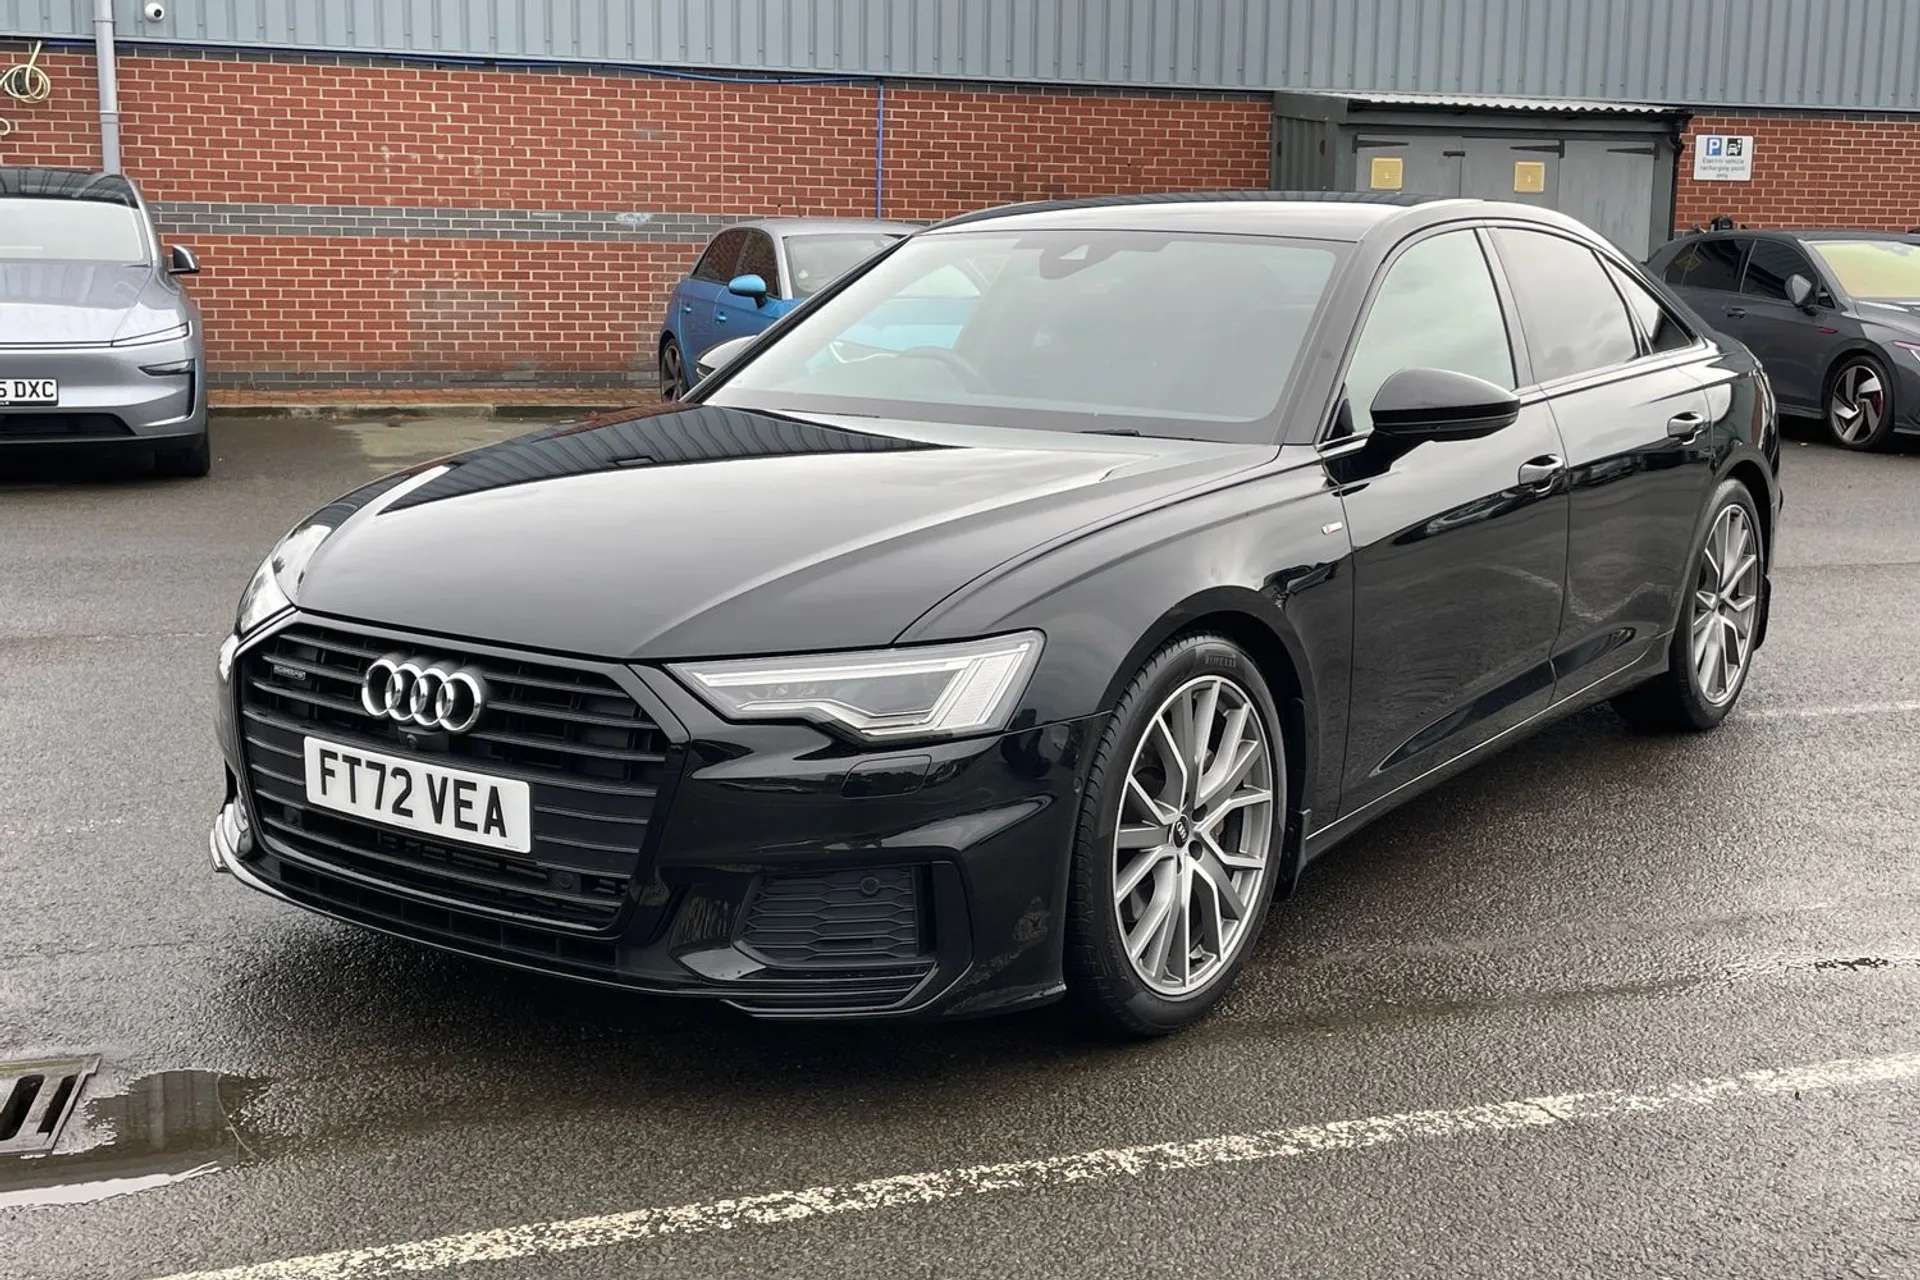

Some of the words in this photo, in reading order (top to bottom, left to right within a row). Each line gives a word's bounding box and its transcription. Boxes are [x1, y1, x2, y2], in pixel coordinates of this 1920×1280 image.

[1708, 139, 1720, 155] P
[14, 381, 54, 398] DXC
[319, 748, 413, 818] FT72
[426, 773, 507, 838] VEA
